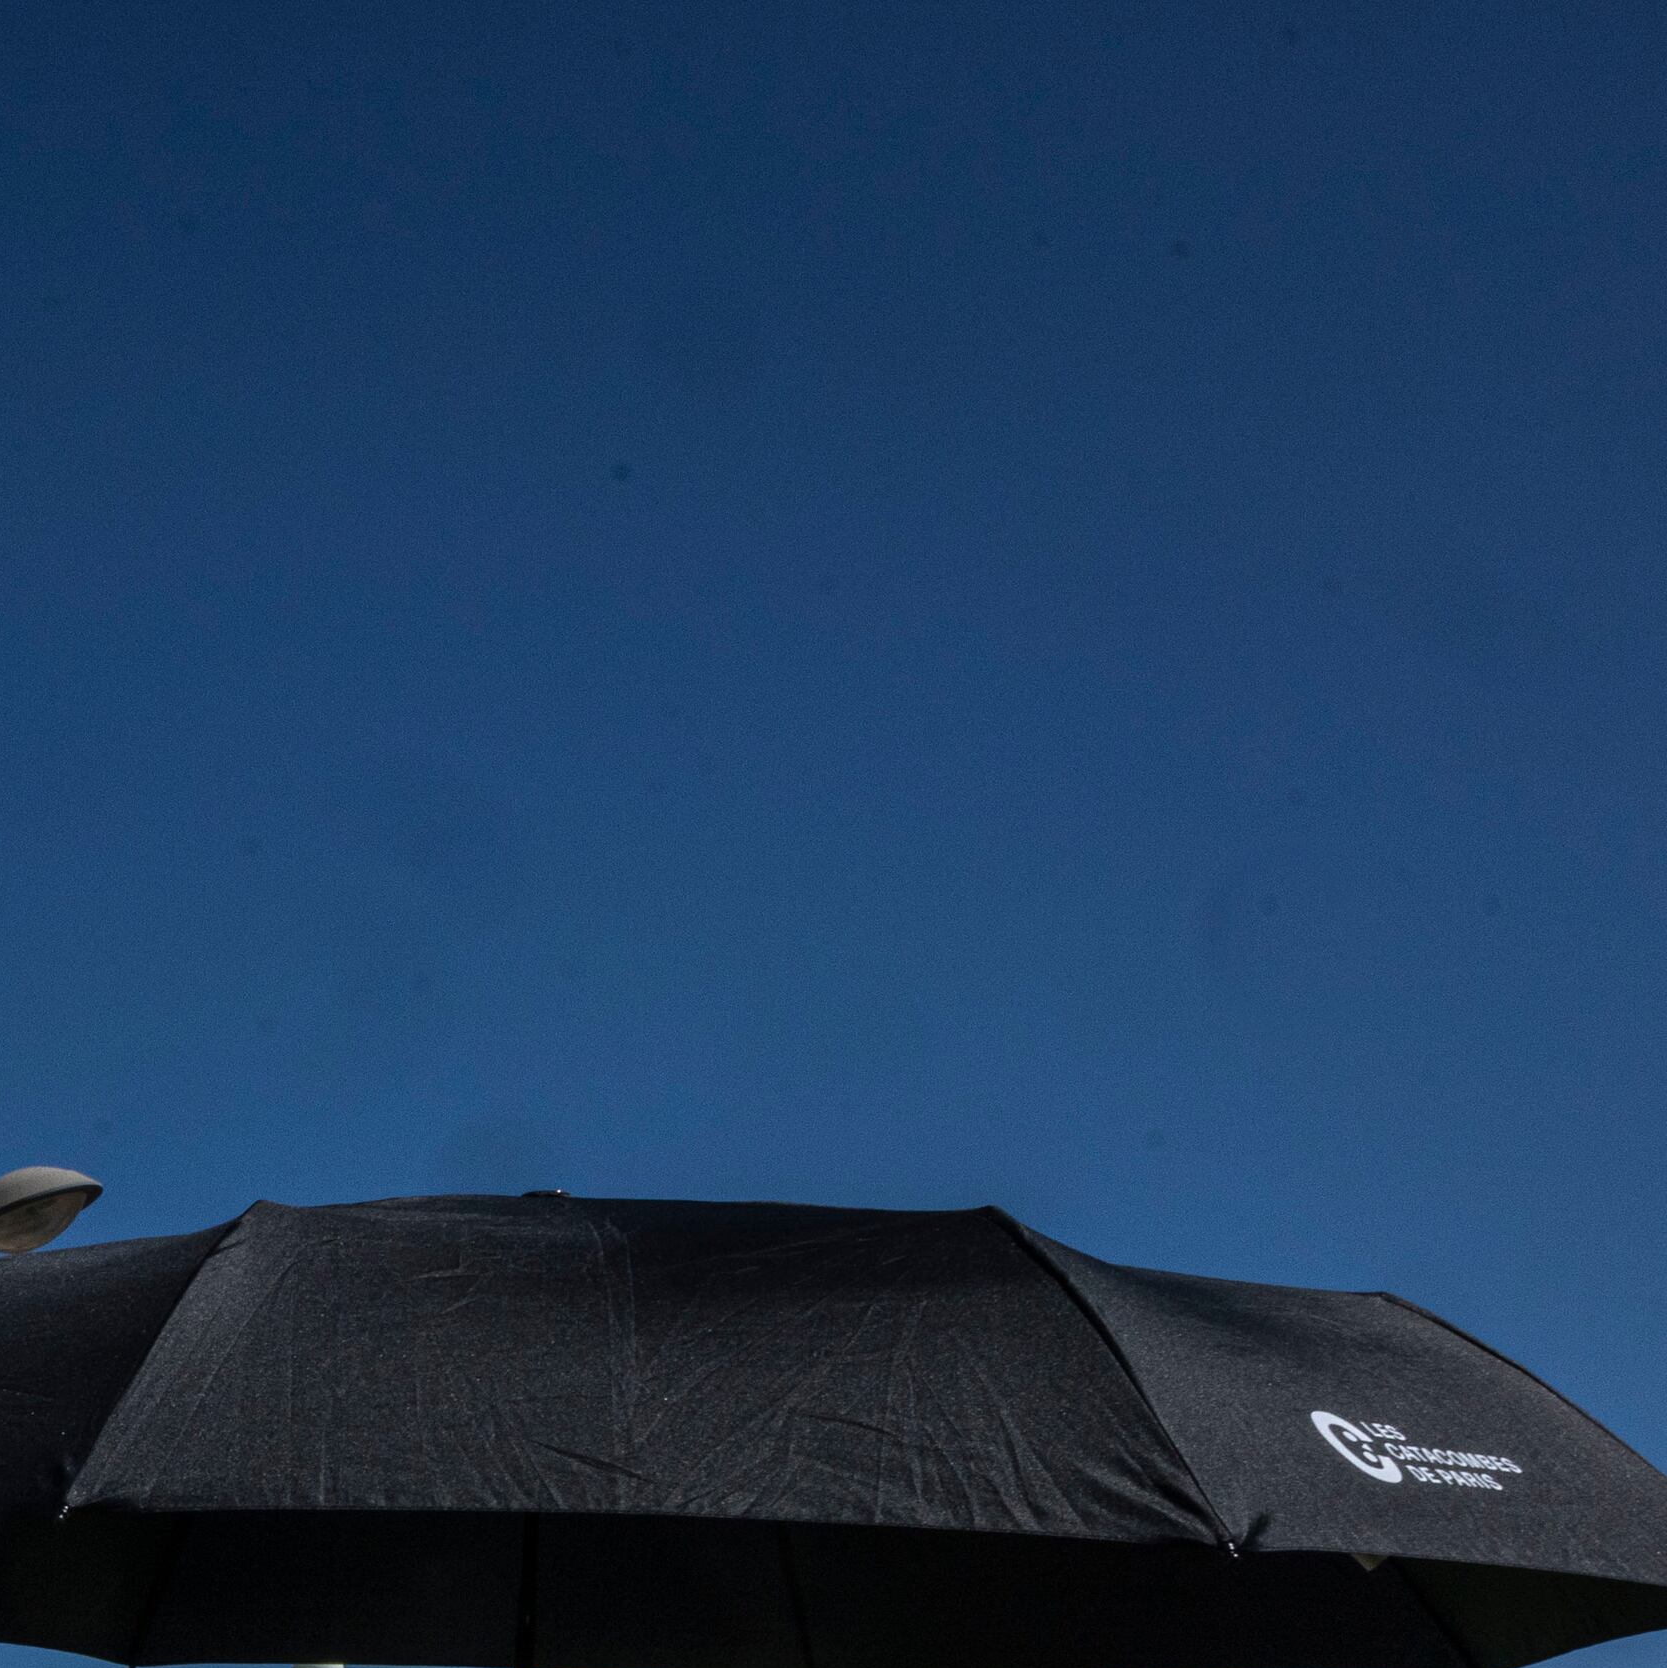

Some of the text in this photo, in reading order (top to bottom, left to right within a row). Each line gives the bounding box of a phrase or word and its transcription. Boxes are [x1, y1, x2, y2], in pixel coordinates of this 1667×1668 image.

[1359, 1421, 1407, 1442] LES
[1383, 1442, 1524, 1474] CATACOMBES
[1405, 1465, 1504, 1491] DE PARIS
